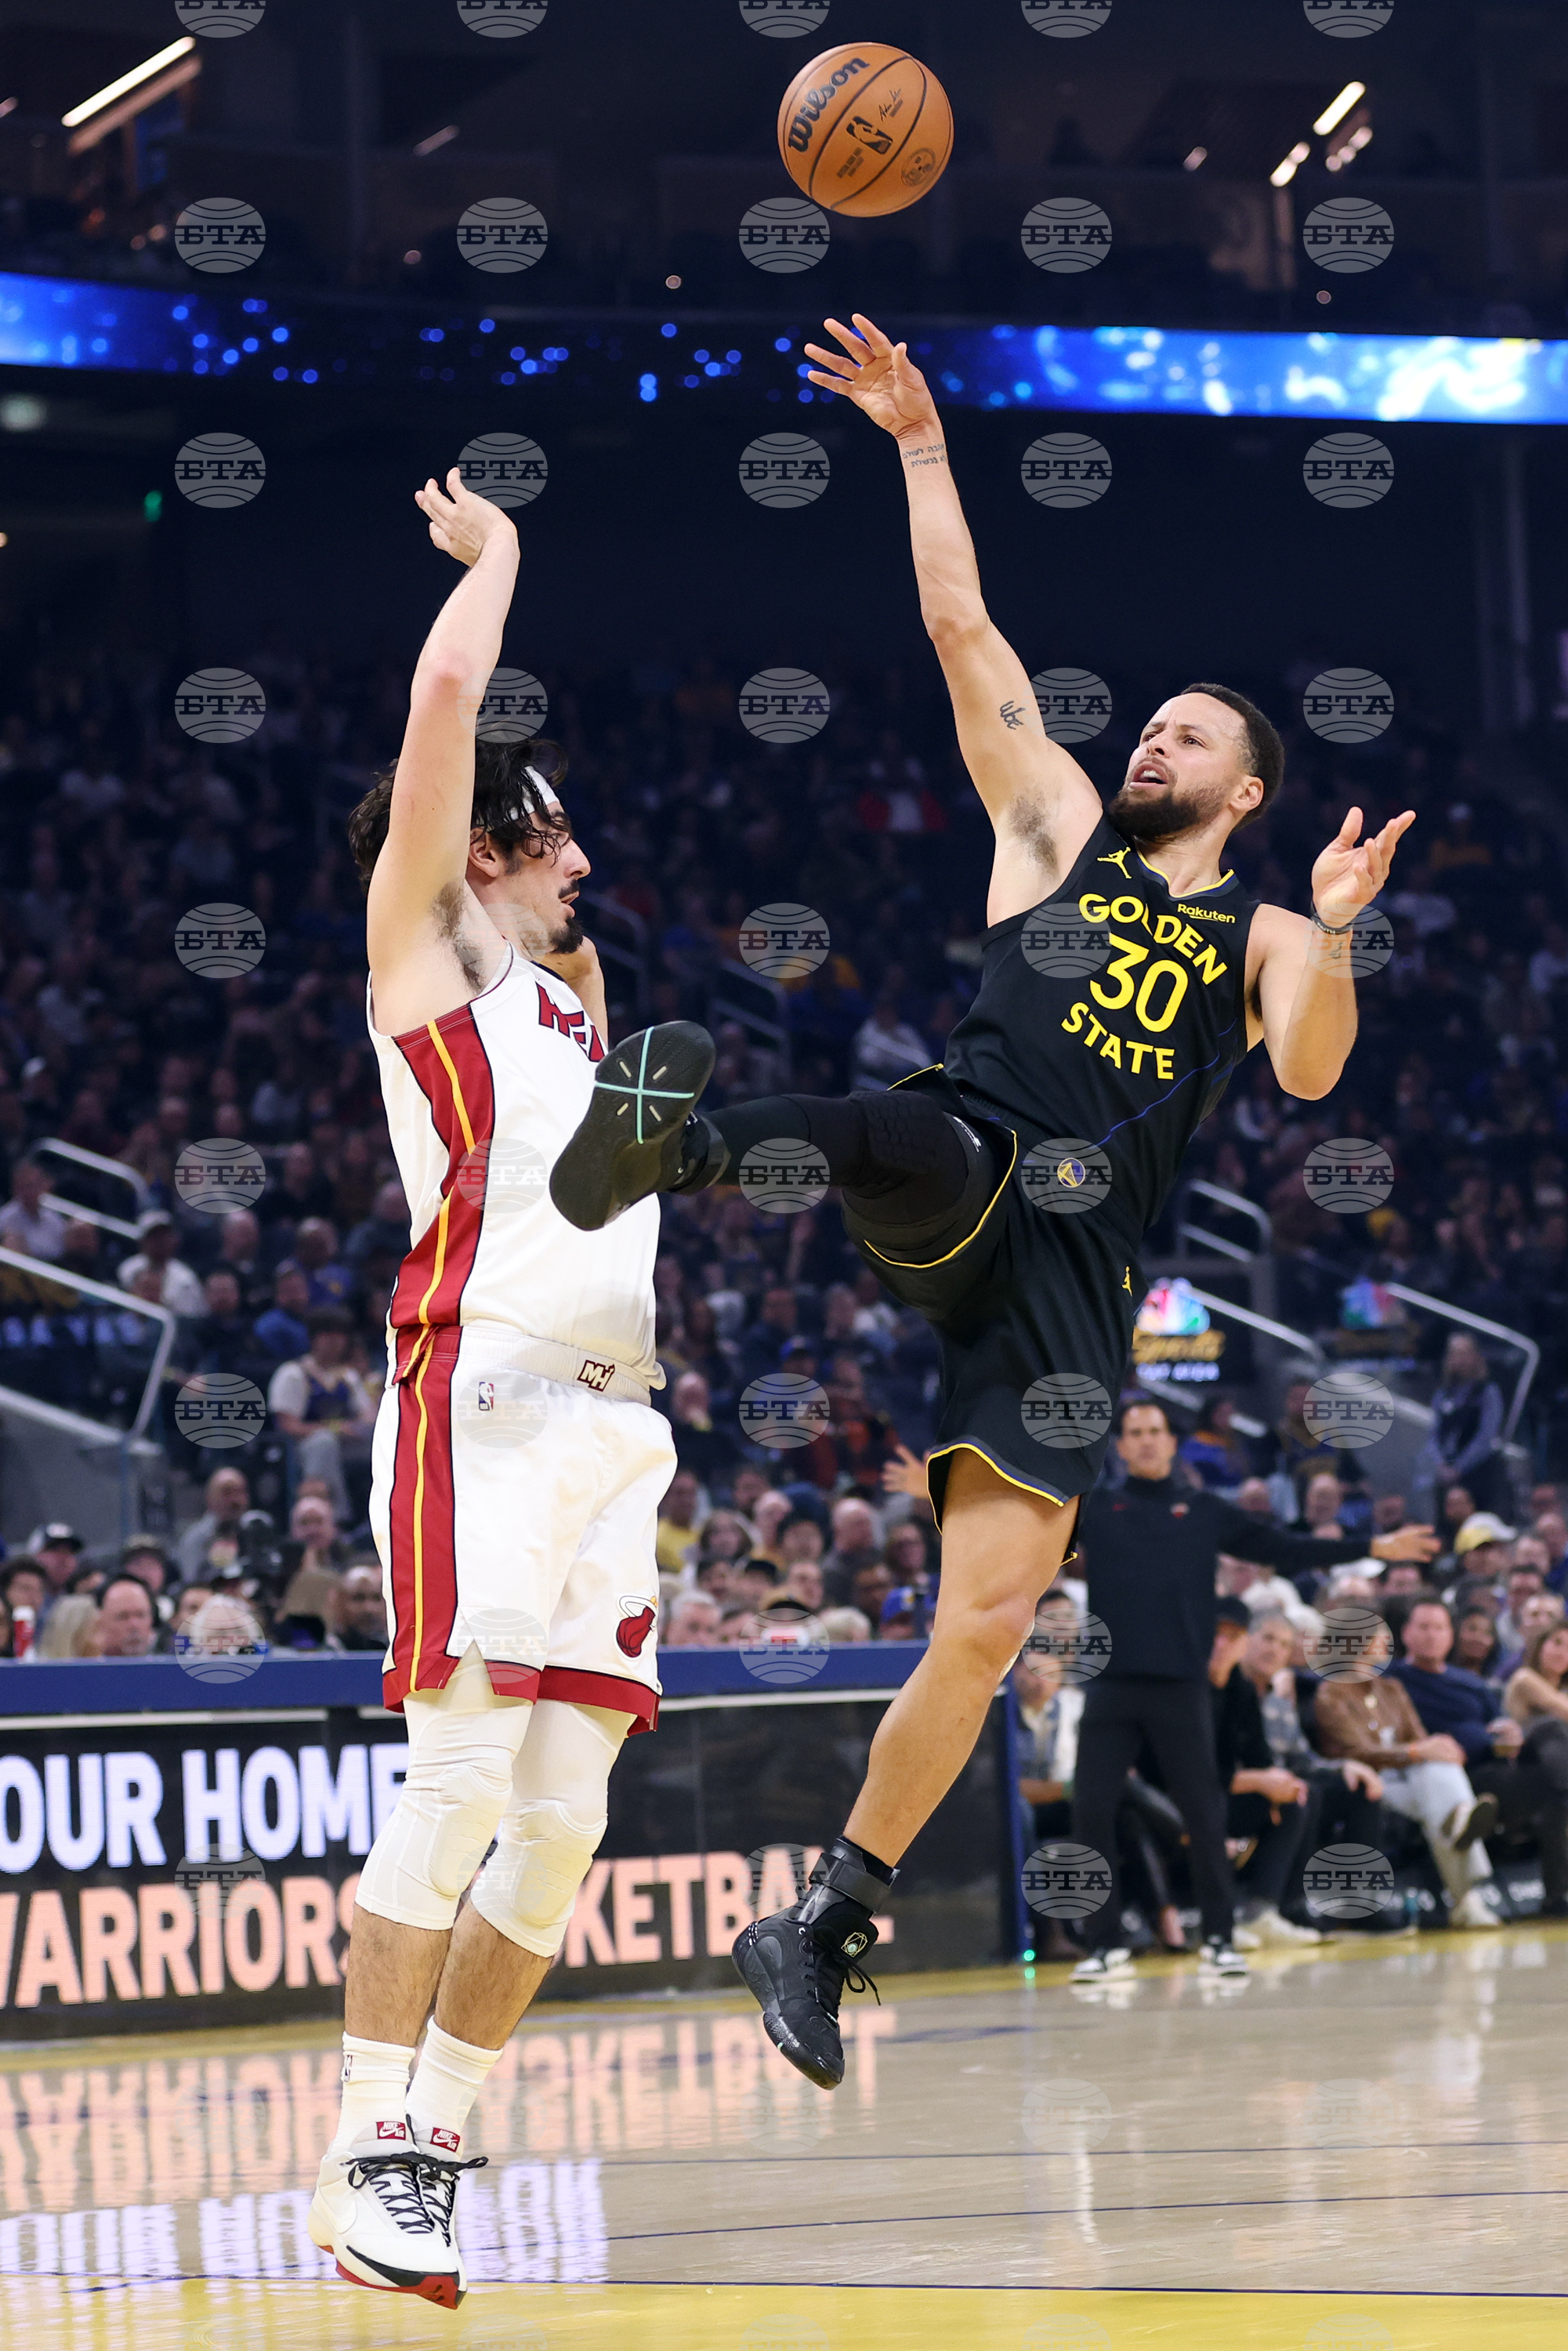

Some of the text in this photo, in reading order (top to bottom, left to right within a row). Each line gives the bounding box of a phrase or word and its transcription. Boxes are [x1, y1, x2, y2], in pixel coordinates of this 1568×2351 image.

[788, 57, 871, 152] Wilson
[1177, 904, 1236, 923] Rakuten
[1090, 933, 1189, 1033] 30
[1061, 1002, 1175, 1080] STATE
[0, 1873, 360, 2009] ARRIOR
[382, 2121, 400, 2131] NIKE
[437, 2129, 455, 2141] NIKE
[447, 2140, 457, 2150] AIR
